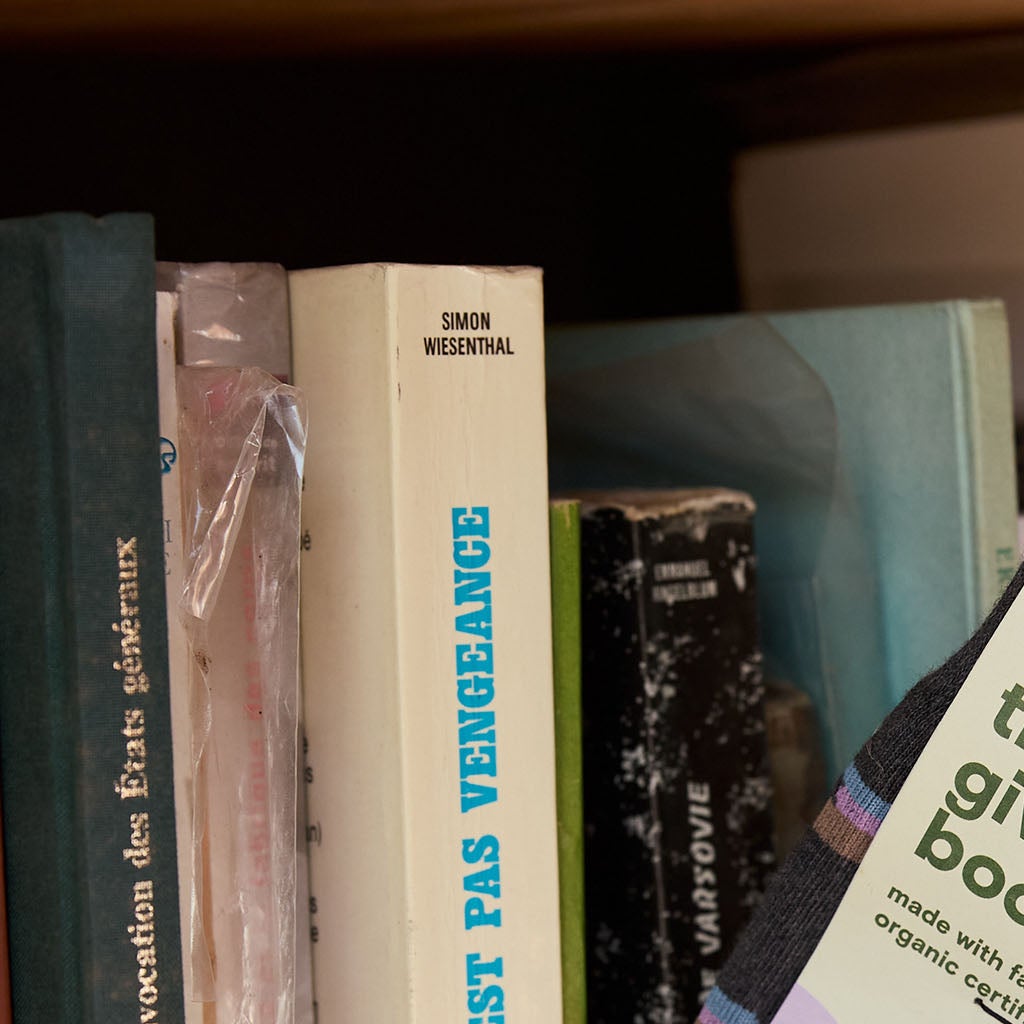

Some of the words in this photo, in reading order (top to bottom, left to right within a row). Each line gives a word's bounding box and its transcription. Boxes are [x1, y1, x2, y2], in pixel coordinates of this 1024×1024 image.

[423, 336, 515, 357] WIESENTHAL
[441, 311, 491, 332] SIMON
[112, 536, 151, 695] généraux
[451, 506, 498, 814] VENGEANCE
[114, 707, 150, 799] États
[123, 811, 151, 868] des
[461, 834, 502, 931] PAS
[687, 781, 722, 955] VARSOVIE
[874, 913, 959, 976] organic
[887, 886, 951, 935] made
[956, 930, 1004, 972] with
